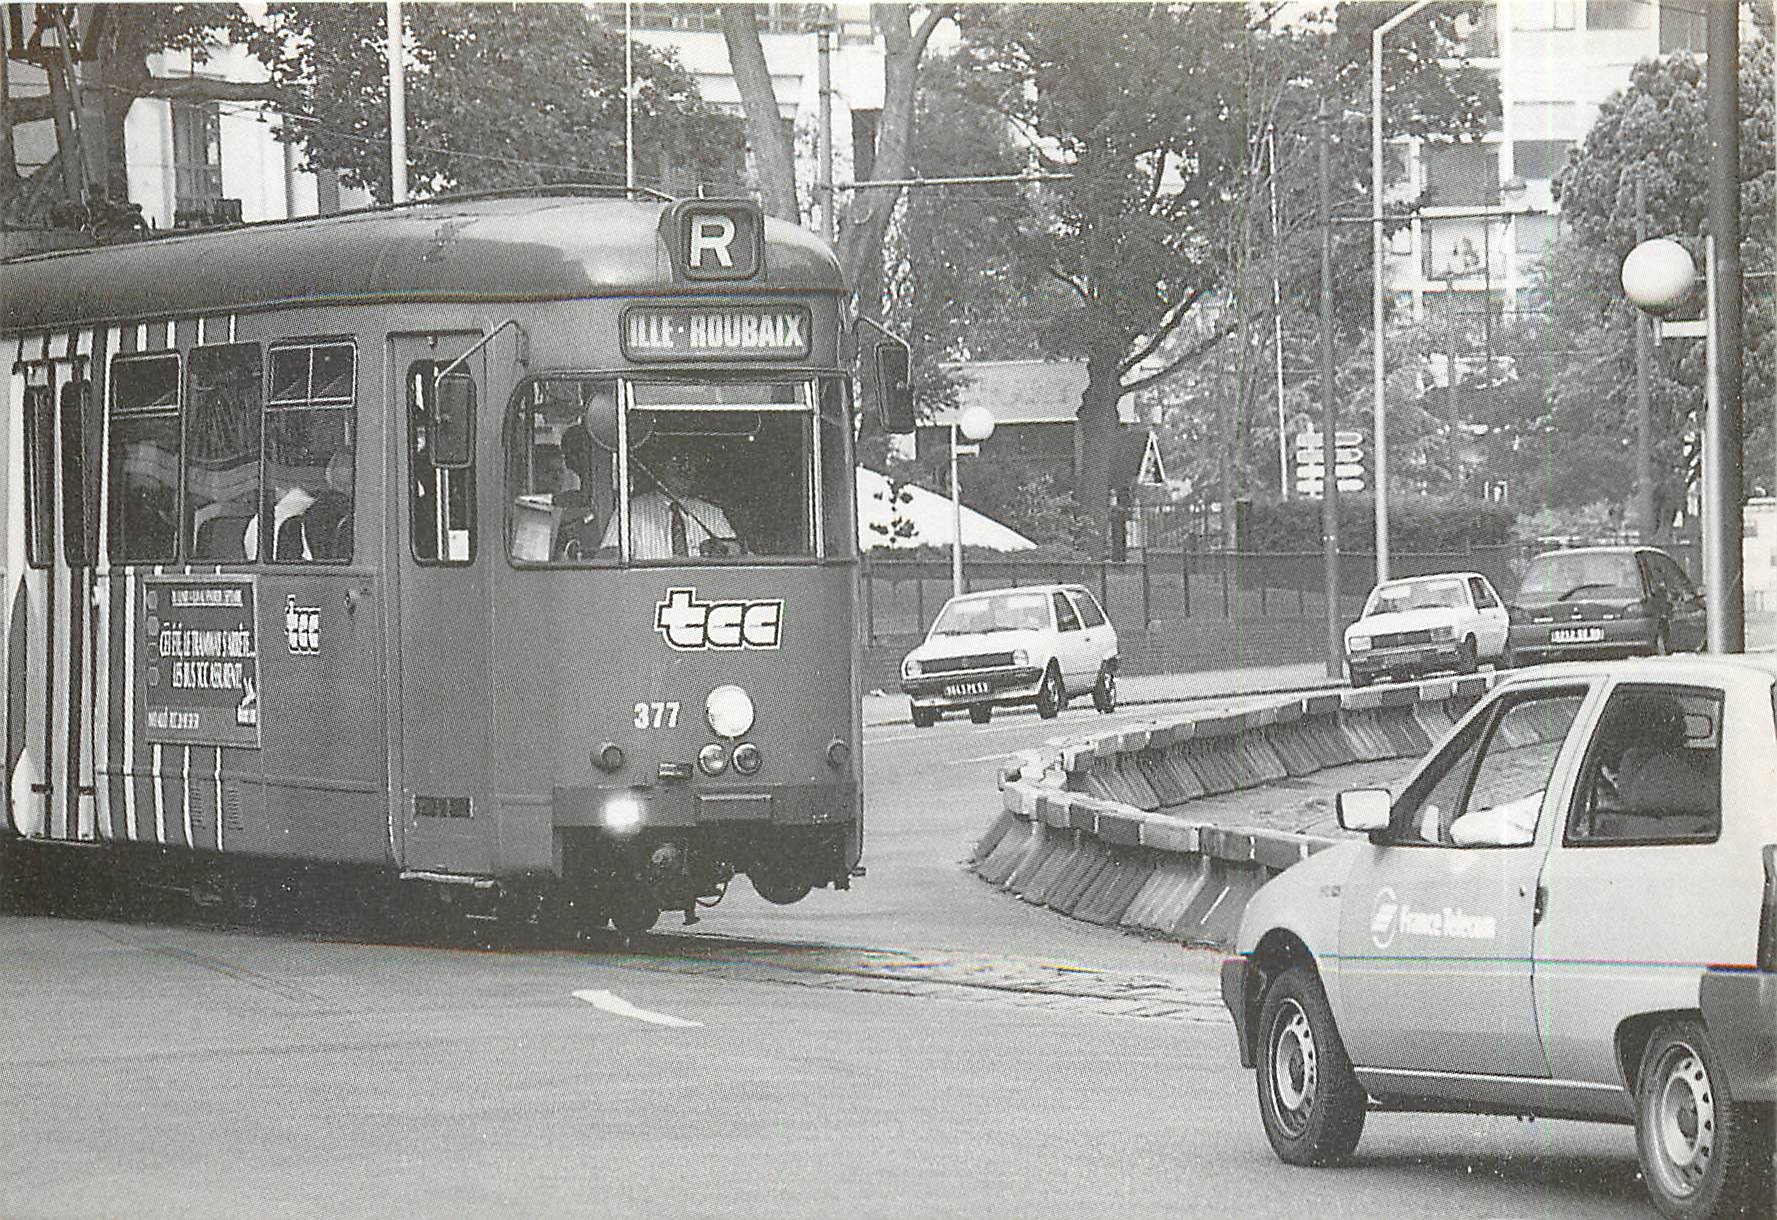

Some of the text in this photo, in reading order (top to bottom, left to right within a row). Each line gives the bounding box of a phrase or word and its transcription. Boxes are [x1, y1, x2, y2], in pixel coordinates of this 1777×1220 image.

[690, 214, 736, 268] R
[690, 314, 803, 348] ROUBAIX
[284, 594, 321, 655] tcc
[654, 587, 784, 650] tcc
[634, 702, 680, 729] 377
